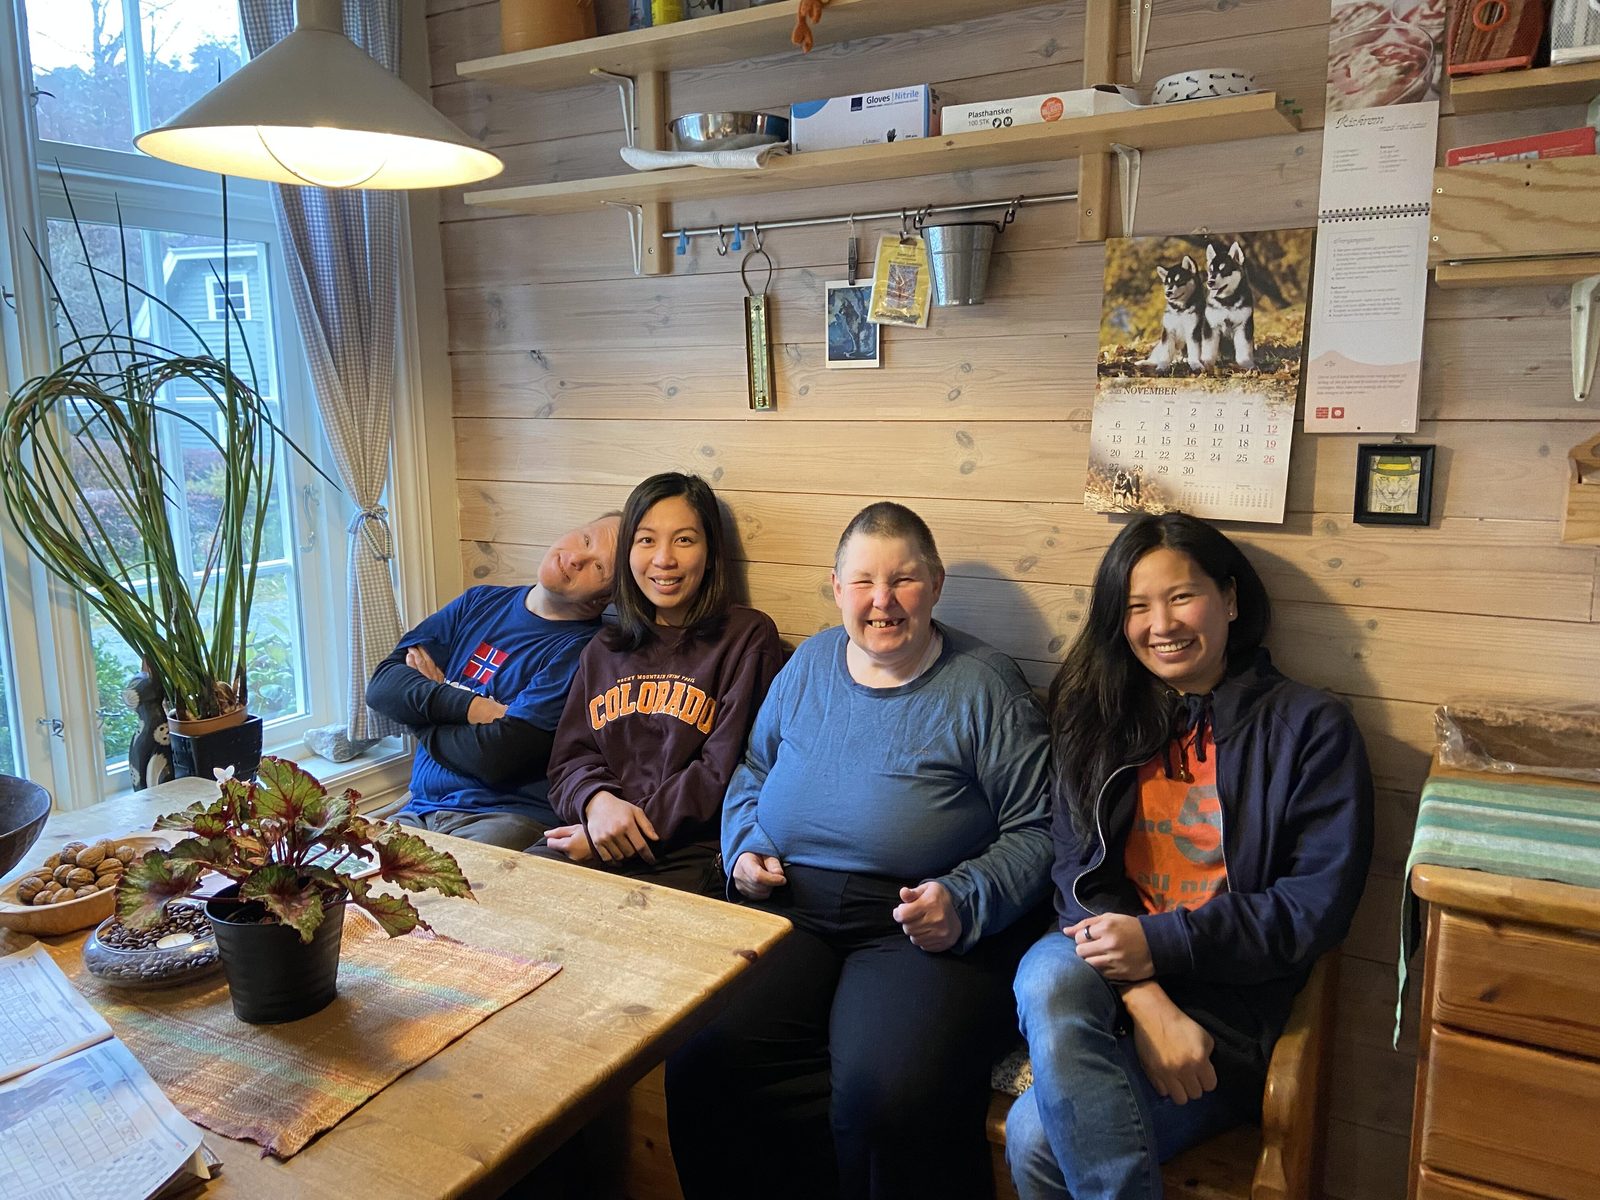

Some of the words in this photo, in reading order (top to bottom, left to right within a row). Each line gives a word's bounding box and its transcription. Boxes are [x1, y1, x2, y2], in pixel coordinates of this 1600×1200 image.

[866, 95, 891, 105] Gloves
[894, 89, 920, 101] Nitrile
[967, 107, 1014, 119] Plasthansker
[1123, 387, 1178, 396] NOVEMBER
[1214, 423, 1225, 432] 10
[1240, 424, 1250, 433] 11
[1267, 425, 1278, 433] 12
[1112, 435, 1122, 443] 13
[1137, 435, 1146, 444] 14
[1161, 436, 1171, 445] 15
[1186, 437, 1197, 446] 16
[1212, 438, 1223, 447] 17
[1240, 439, 1249, 447] 18
[1265, 440, 1277, 449] 19
[1110, 449, 1121, 457] 20
[1134, 450, 1144, 458] 21
[1159, 451, 1170, 459] 22
[1184, 452, 1195, 460] 23
[1210, 453, 1221, 461] 24
[1236, 454, 1248, 462] 25
[1263, 455, 1275, 464] 26
[1133, 464, 1144, 473] 28
[1158, 465, 1169, 474] 29
[1183, 466, 1194, 475] 30
[588, 680, 717, 735] COLORADO
